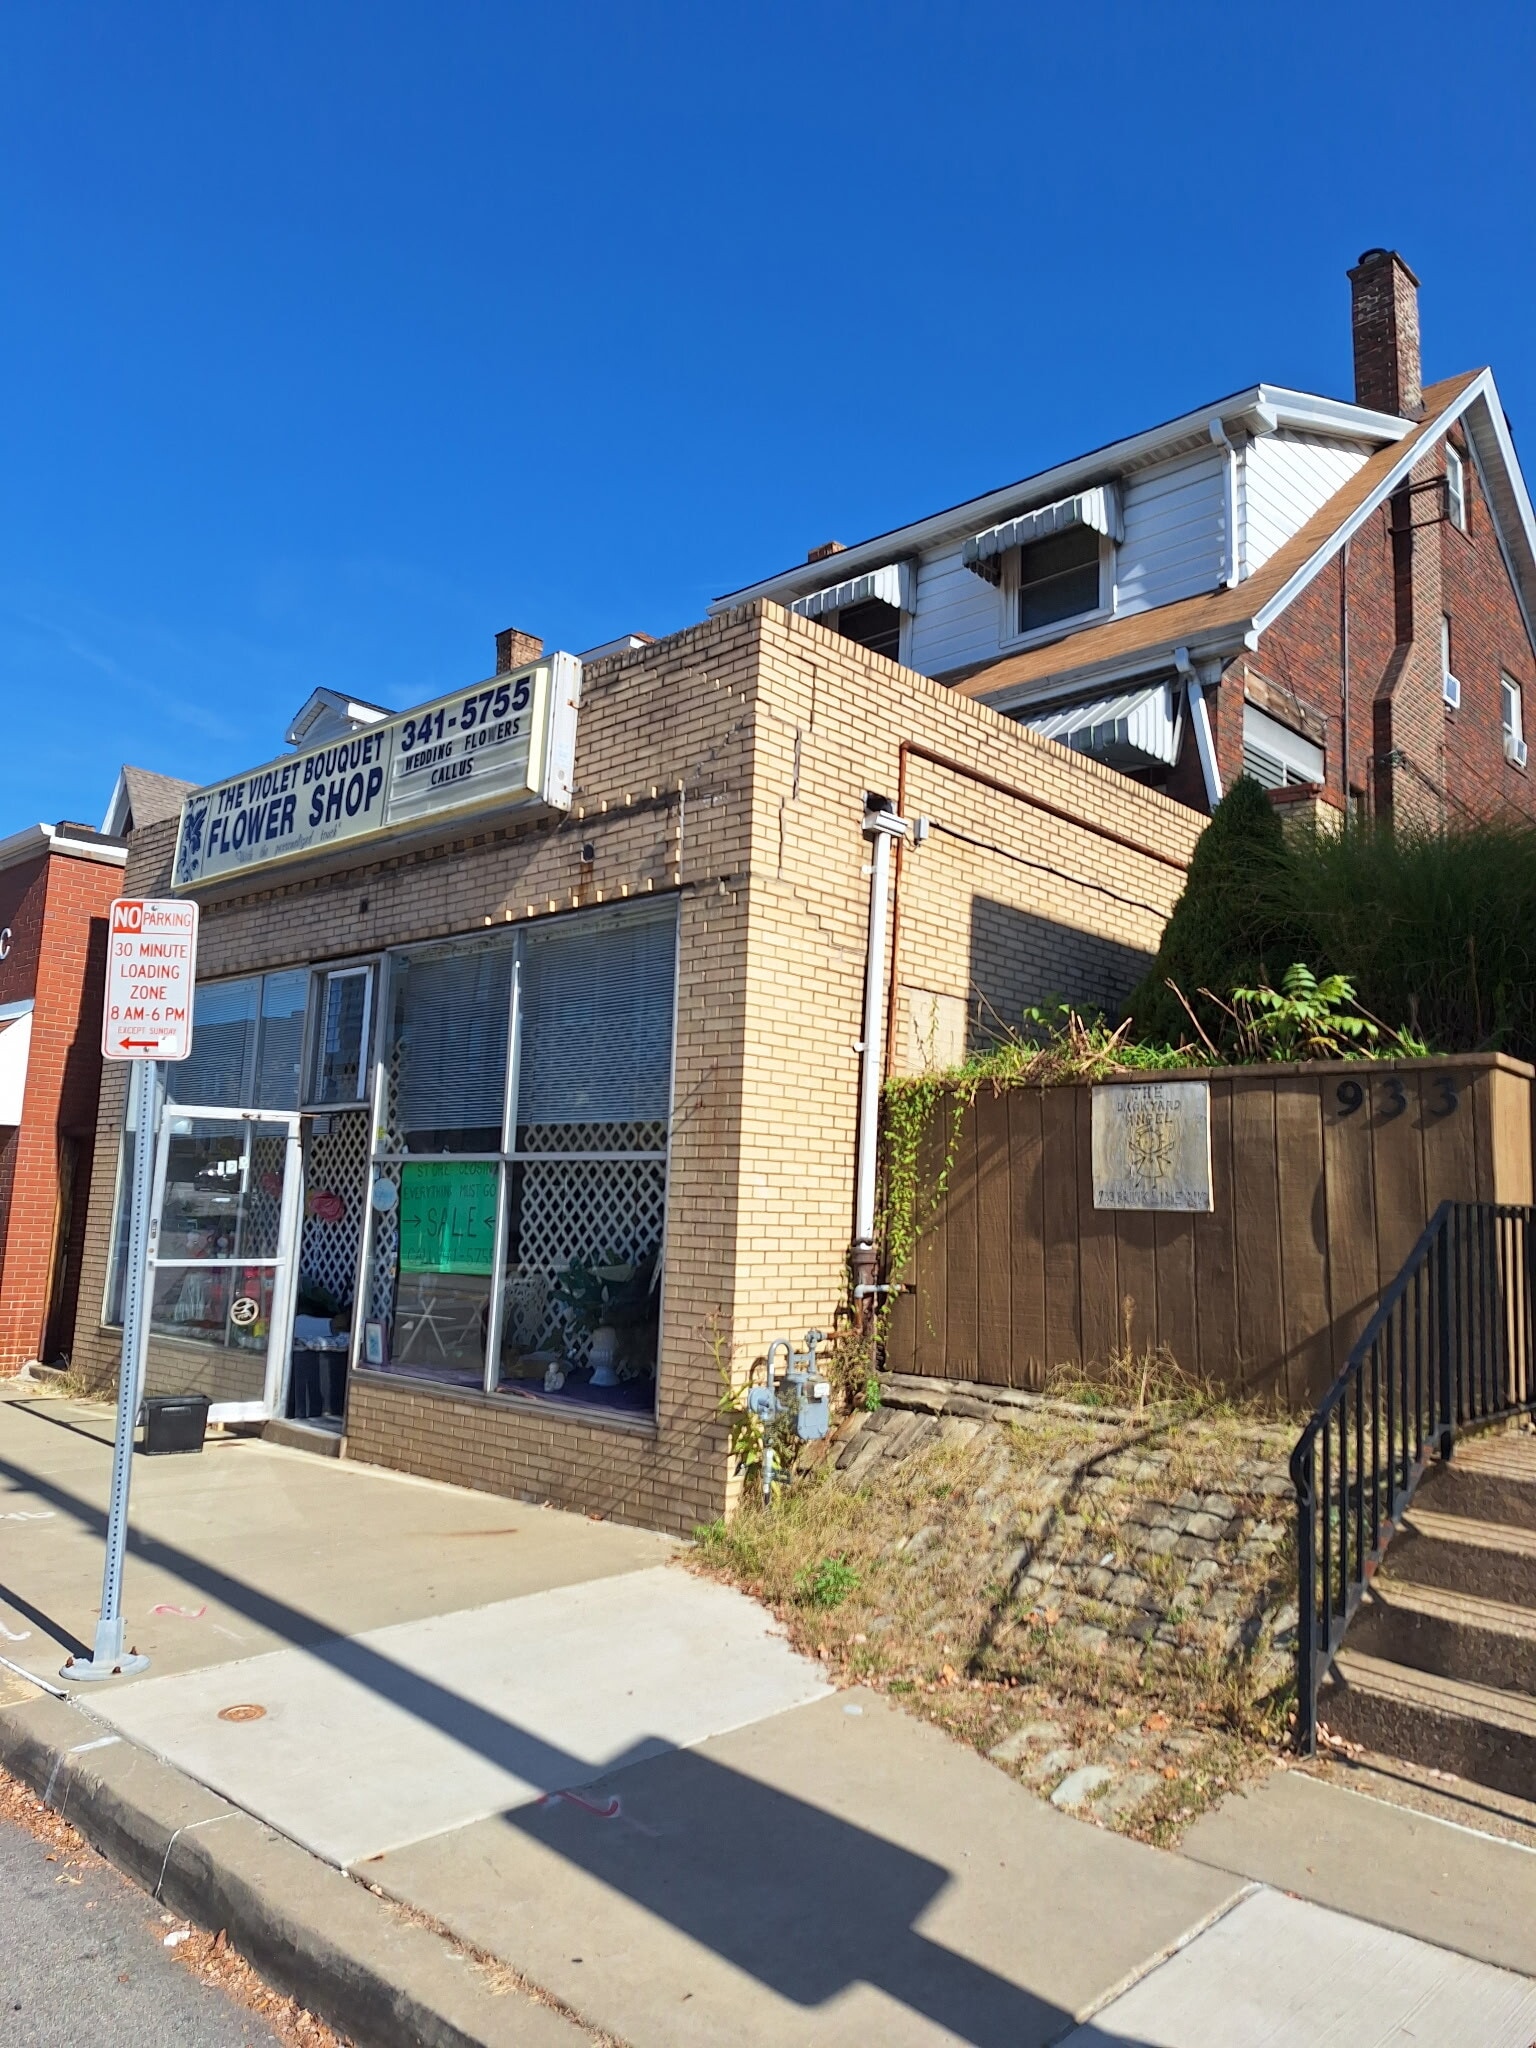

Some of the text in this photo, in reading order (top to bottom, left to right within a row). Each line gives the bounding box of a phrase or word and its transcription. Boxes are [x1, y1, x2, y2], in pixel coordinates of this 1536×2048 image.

[401, 676, 530, 752] 341-5755
[405, 718, 520, 771] WEDDING FLOWERS
[218, 731, 385, 815] THE VIOLET BOUQUET
[207, 766, 383, 858] FLOWER SHOP
[113, 905, 191, 928] NO PARKING
[115, 943, 187, 958] 30 MINUTE
[120, 964, 180, 979] LOADING
[130, 985, 167, 1000] ZONE
[111, 1006, 119, 1020] 8
[165, 1008, 184, 1021] PM
[118, 1026, 176, 1035] EXCEPT SUNDAY
[1131, 1085, 1163, 1099] THE
[1336, 1078, 1458, 1117] 933
[459, 1183, 480, 1198] MUST
[483, 1183, 497, 1197] GO
[427, 1206, 477, 1238] SALE
